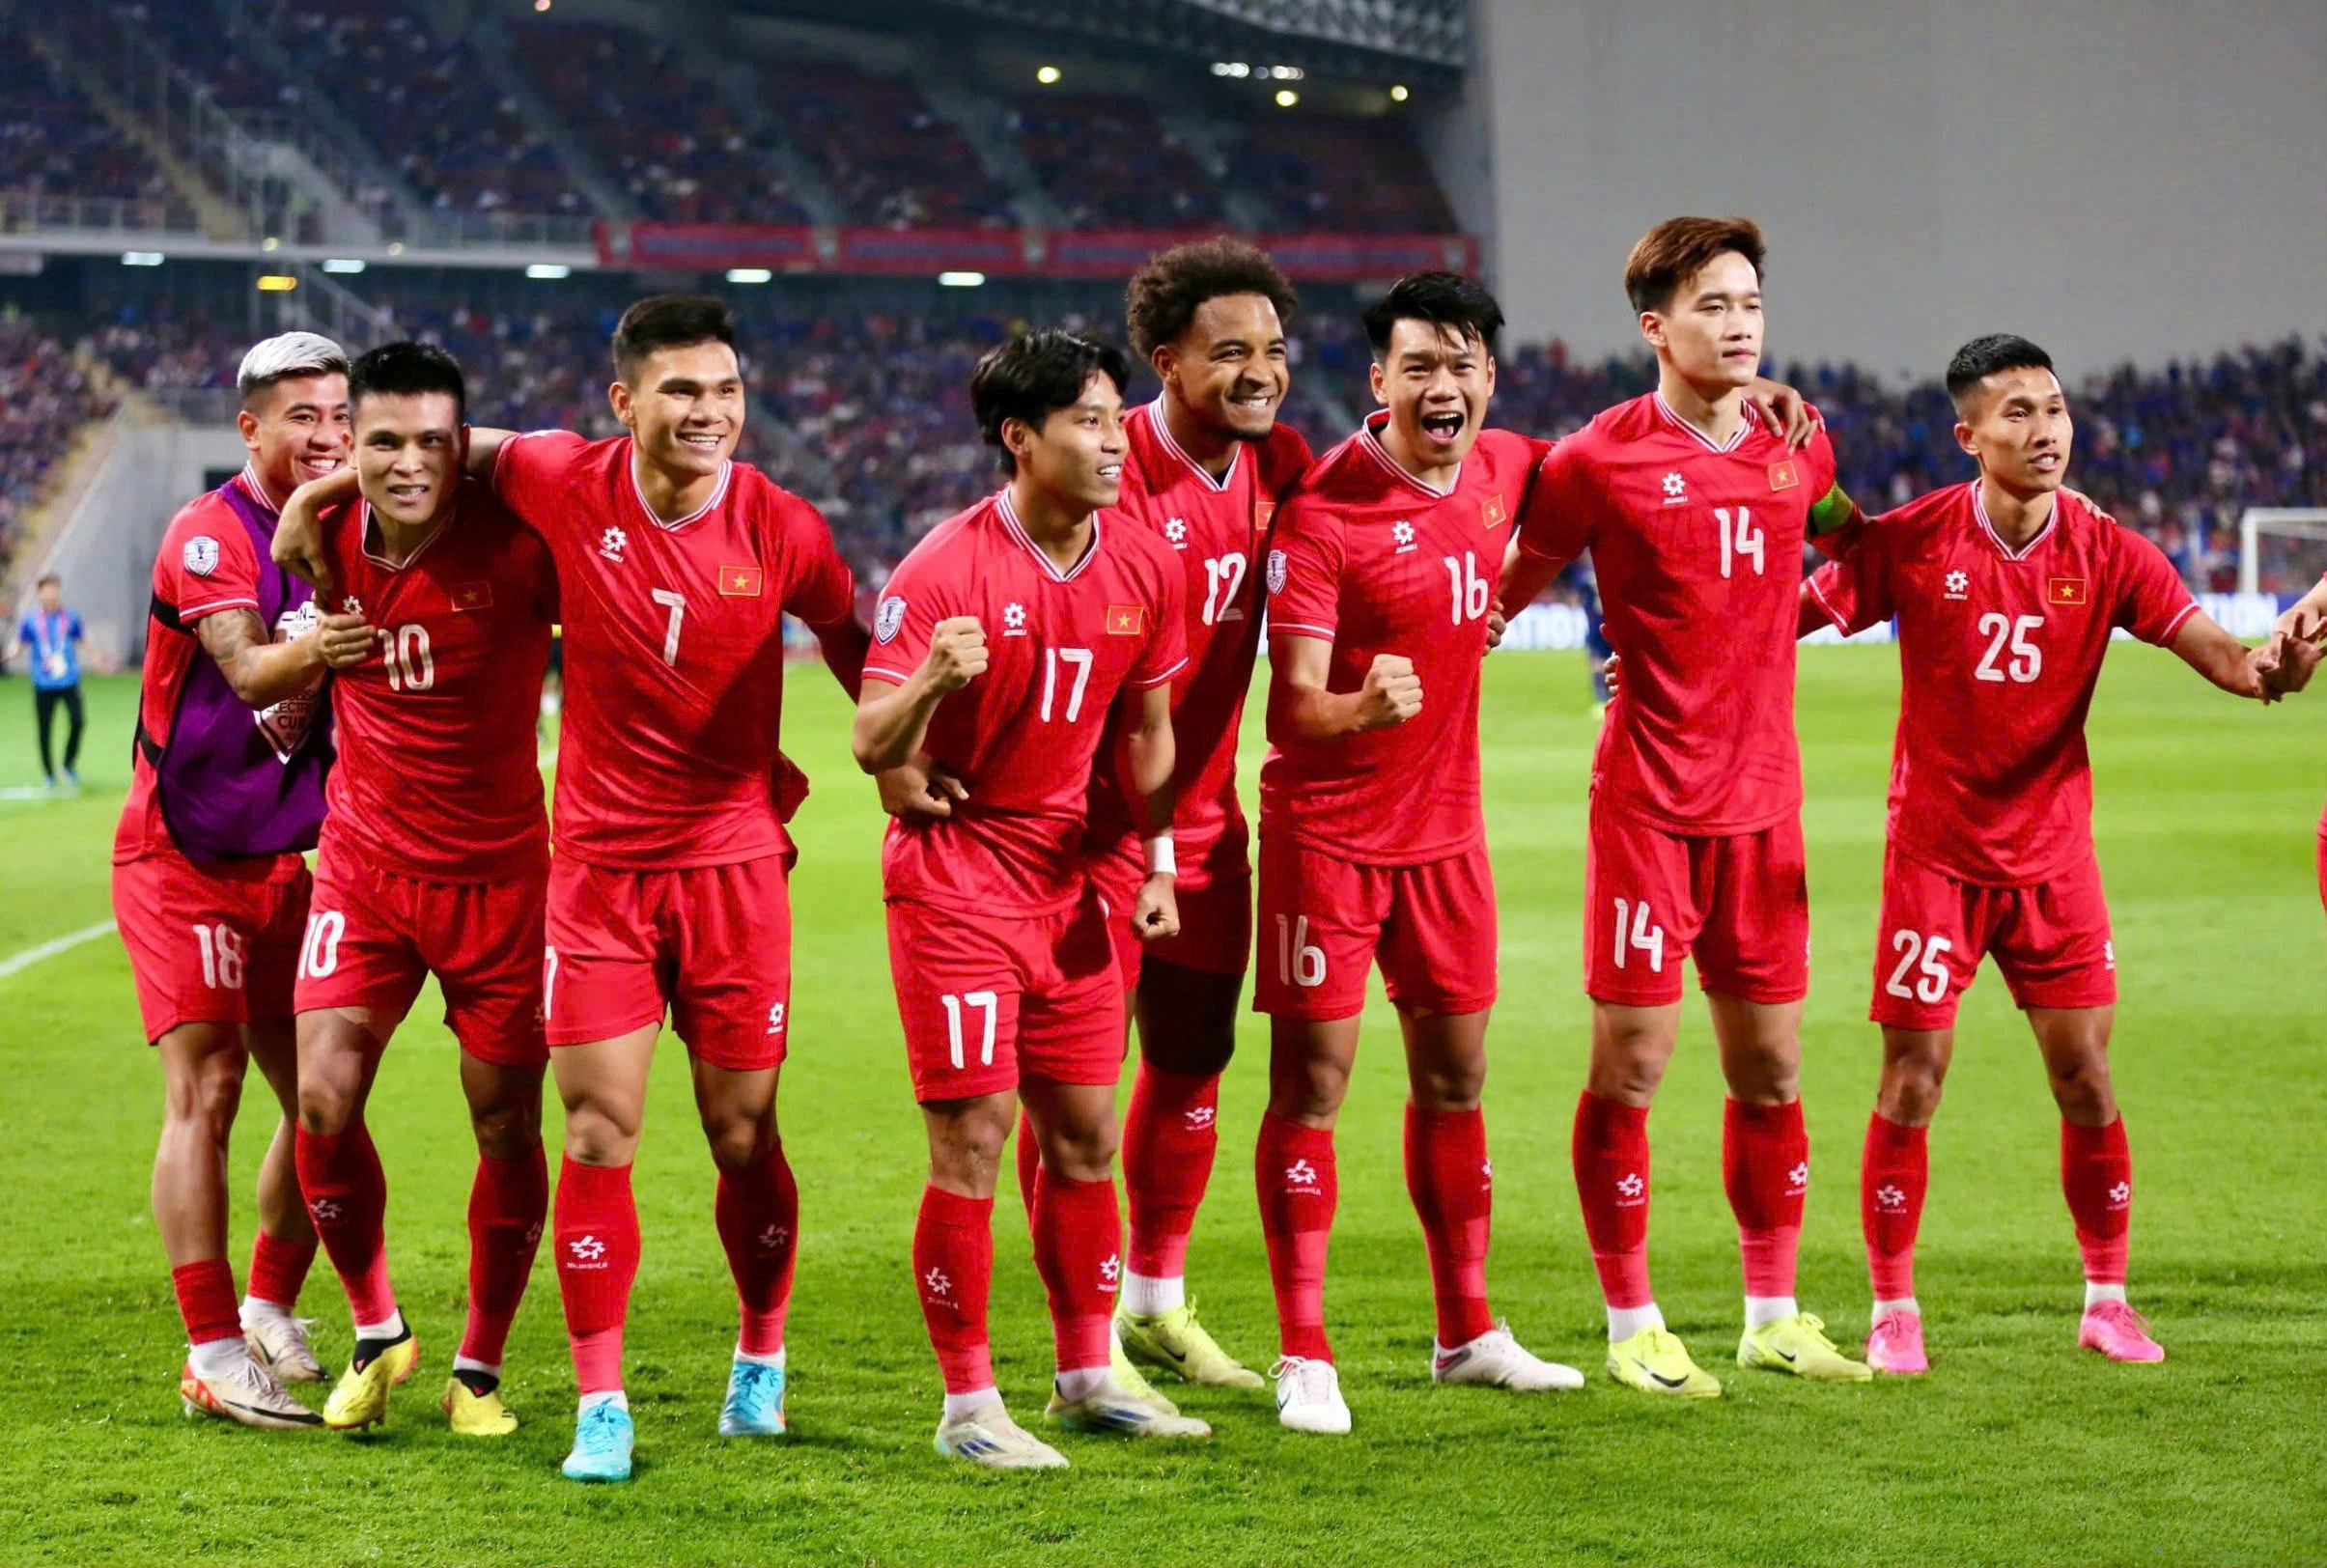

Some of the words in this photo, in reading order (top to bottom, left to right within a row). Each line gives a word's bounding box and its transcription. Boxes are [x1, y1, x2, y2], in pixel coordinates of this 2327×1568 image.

[1714, 506, 1765, 579] 14
[1202, 552, 1247, 626] 12
[1444, 550, 1489, 627] 16
[378, 624, 434, 691] 10
[652, 587, 686, 667] 7
[1975, 612, 2045, 684] 25
[1041, 648, 1094, 722] 17
[193, 923, 241, 990] 18
[298, 910, 346, 981] 10
[1276, 912, 1327, 987] 16
[1613, 897, 1664, 973] 14
[1886, 929, 1952, 1004] 25
[941, 991, 997, 1070] 17
